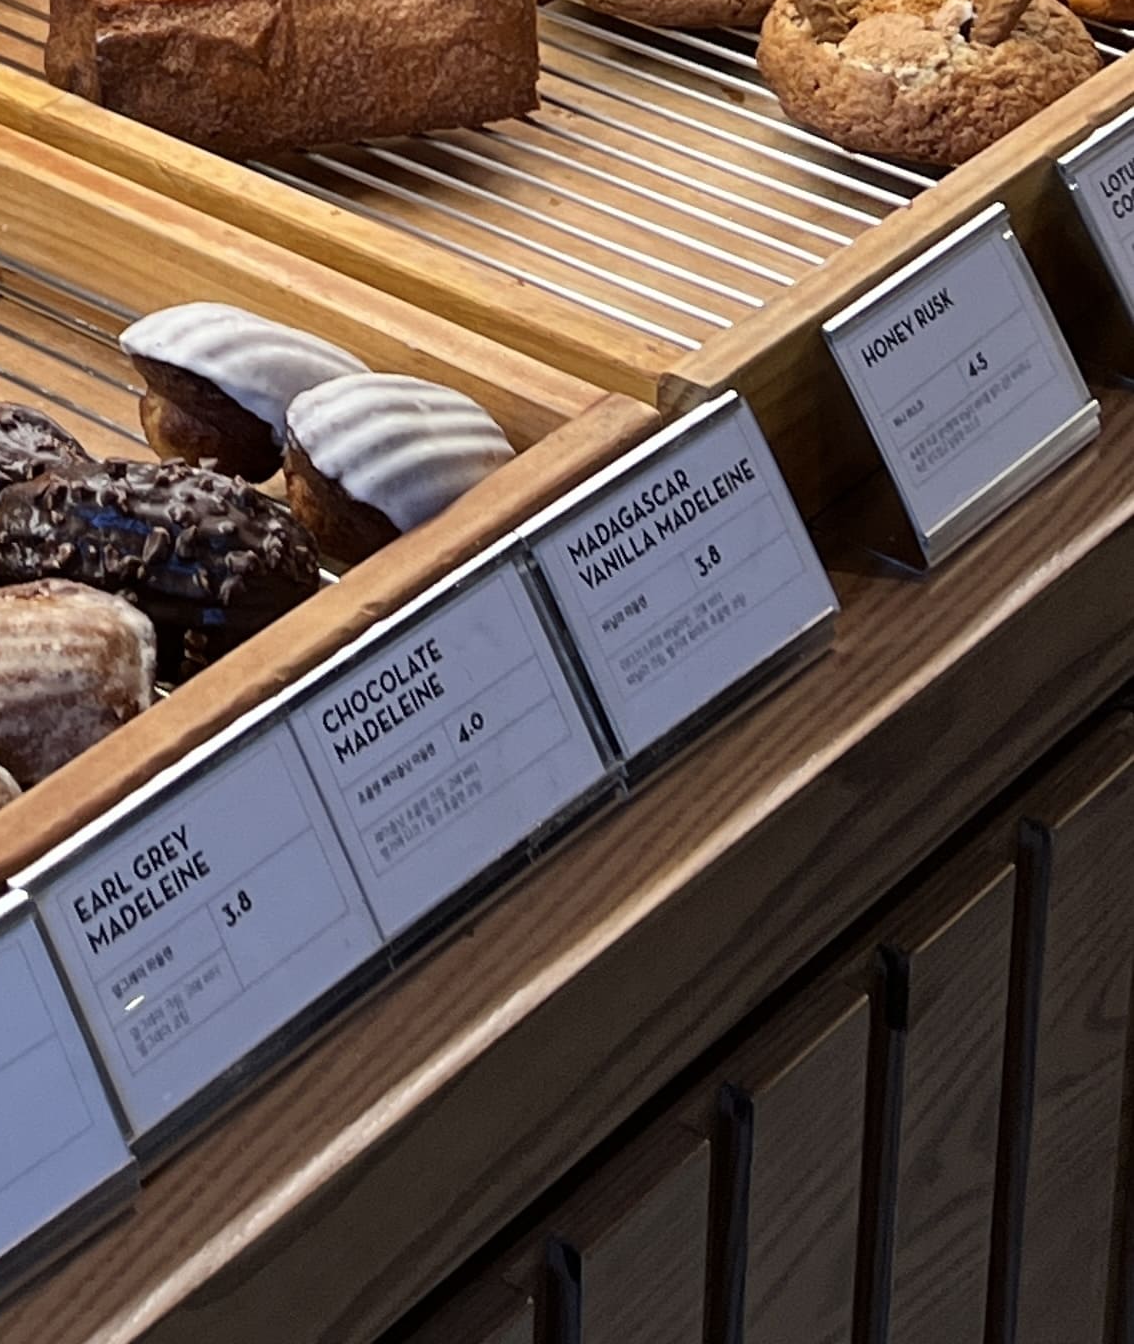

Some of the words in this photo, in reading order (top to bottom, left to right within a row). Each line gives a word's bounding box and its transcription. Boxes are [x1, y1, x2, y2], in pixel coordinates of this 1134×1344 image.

[1100, 158, 1134, 198] LOTU
[1112, 188, 1134, 218] CO
[860, 319, 916, 368] HONEY
[916, 287, 955, 329] RUSK
[567, 469, 691, 566] MADAGASCAR
[578, 527, 658, 591] VANILLA
[658, 458, 756, 541] MADELEINE
[695, 545, 722, 577] 3.8
[322, 638, 444, 734] CHOCOLATE
[332, 672, 445, 764] MADELEINE
[458, 712, 485, 743] 4.0
[73, 871, 132, 924] EARL
[133, 824, 191, 880] GREY
[86, 850, 211, 955] MADELEINE
[222, 889, 253, 928] 3.8
